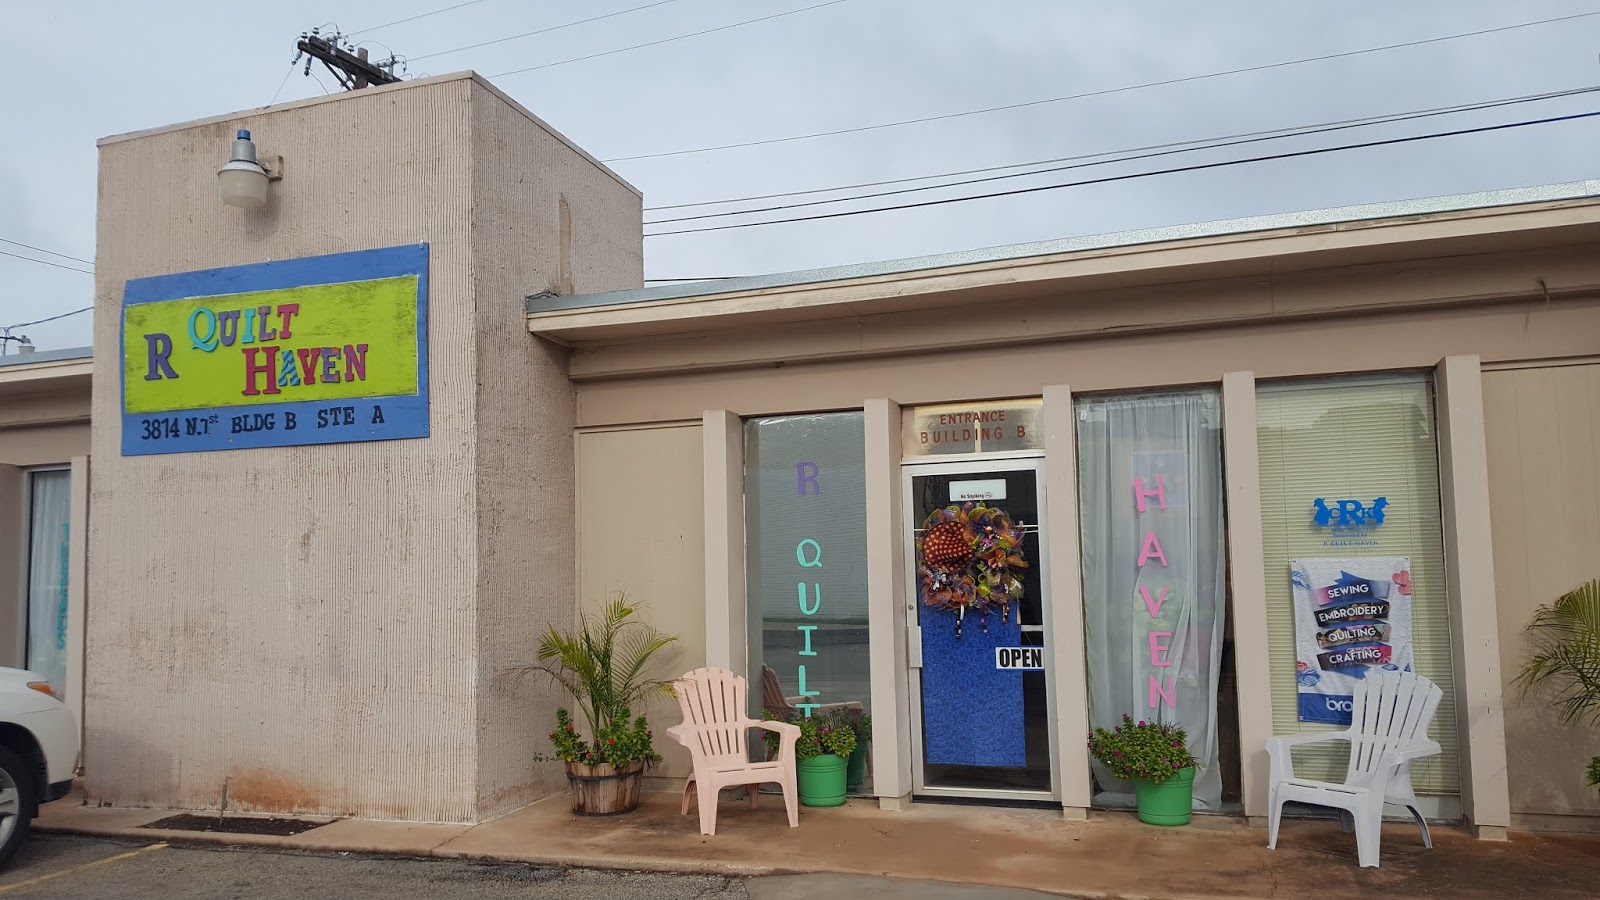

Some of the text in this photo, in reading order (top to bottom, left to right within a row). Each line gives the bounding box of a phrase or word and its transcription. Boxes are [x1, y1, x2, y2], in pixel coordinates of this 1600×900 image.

[187, 303, 299, 351] QUILT
[143, 332, 179, 380] R
[241, 344, 368, 395] HAVEN
[141, 417, 180, 440] 3814
[230, 413, 275, 434] BLDG
[285, 411, 297, 431] B
[317, 405, 355, 429] STE
[371, 405, 385, 425] A
[940, 410, 1005, 425] ENTRANCE
[920, 425, 1026, 444] BUILDING B
[796, 461, 820, 497] R
[1133, 474, 1176, 709] HAVEN
[1328, 584, 1369, 598] SEWING
[1318, 605, 1384, 623] EMBROIDERY
[1328, 627, 1376, 642] QUILTING
[999, 648, 1042, 667] OPEN
[1329, 649, 1382, 664] CRAFTING
[1325, 697, 1353, 712] bro
